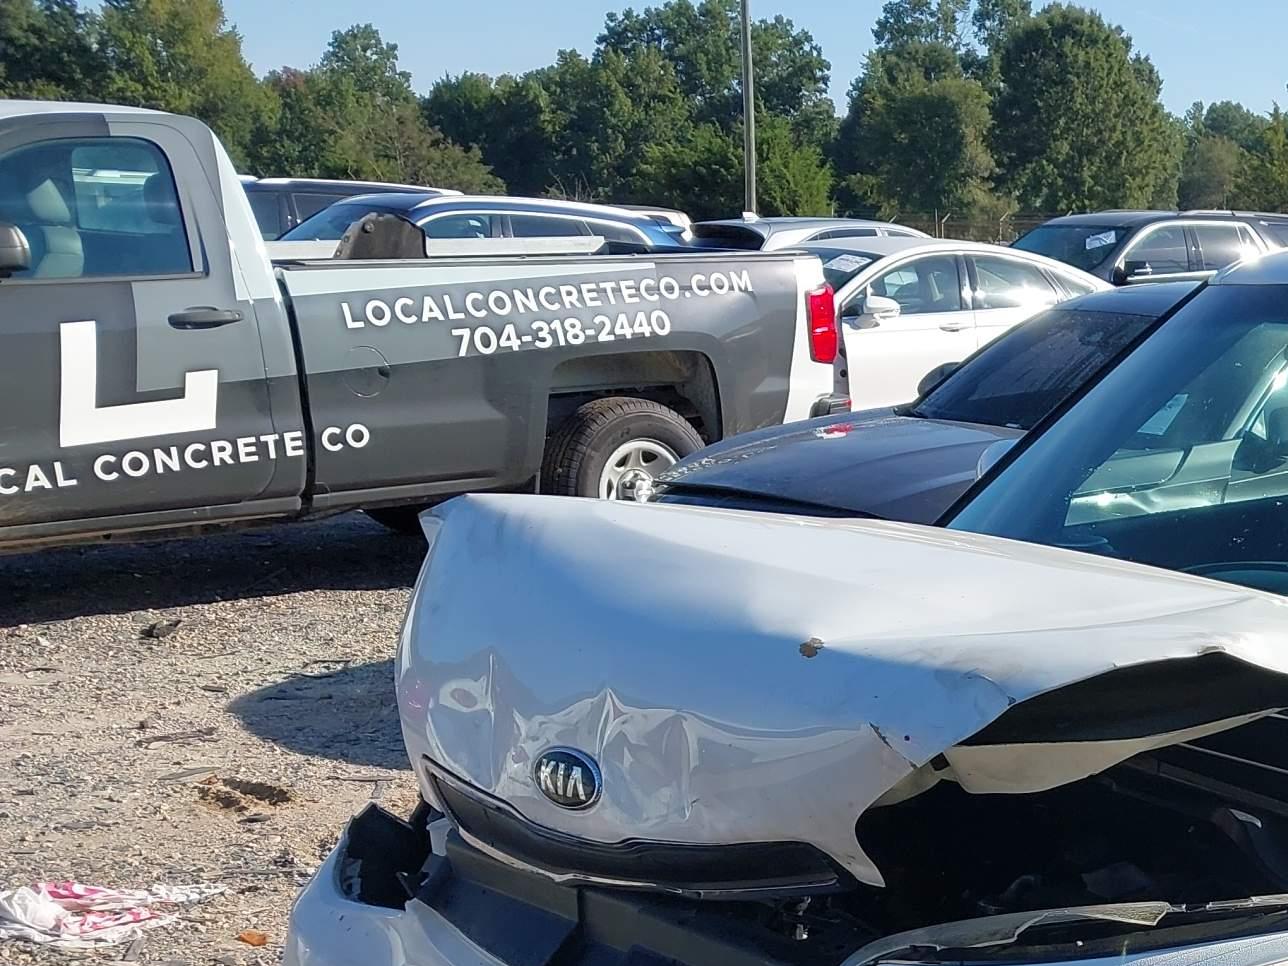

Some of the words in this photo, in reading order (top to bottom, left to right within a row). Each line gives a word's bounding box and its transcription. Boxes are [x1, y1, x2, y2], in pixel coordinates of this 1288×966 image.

[340, 269, 754, 329] LOCALCONCRETECO.COM
[451, 309, 672, 357] 704-318-2440
[93, 431, 305, 481] CONCRETE
[321, 423, 371, 452] CO
[540, 758, 586, 801] KIA
